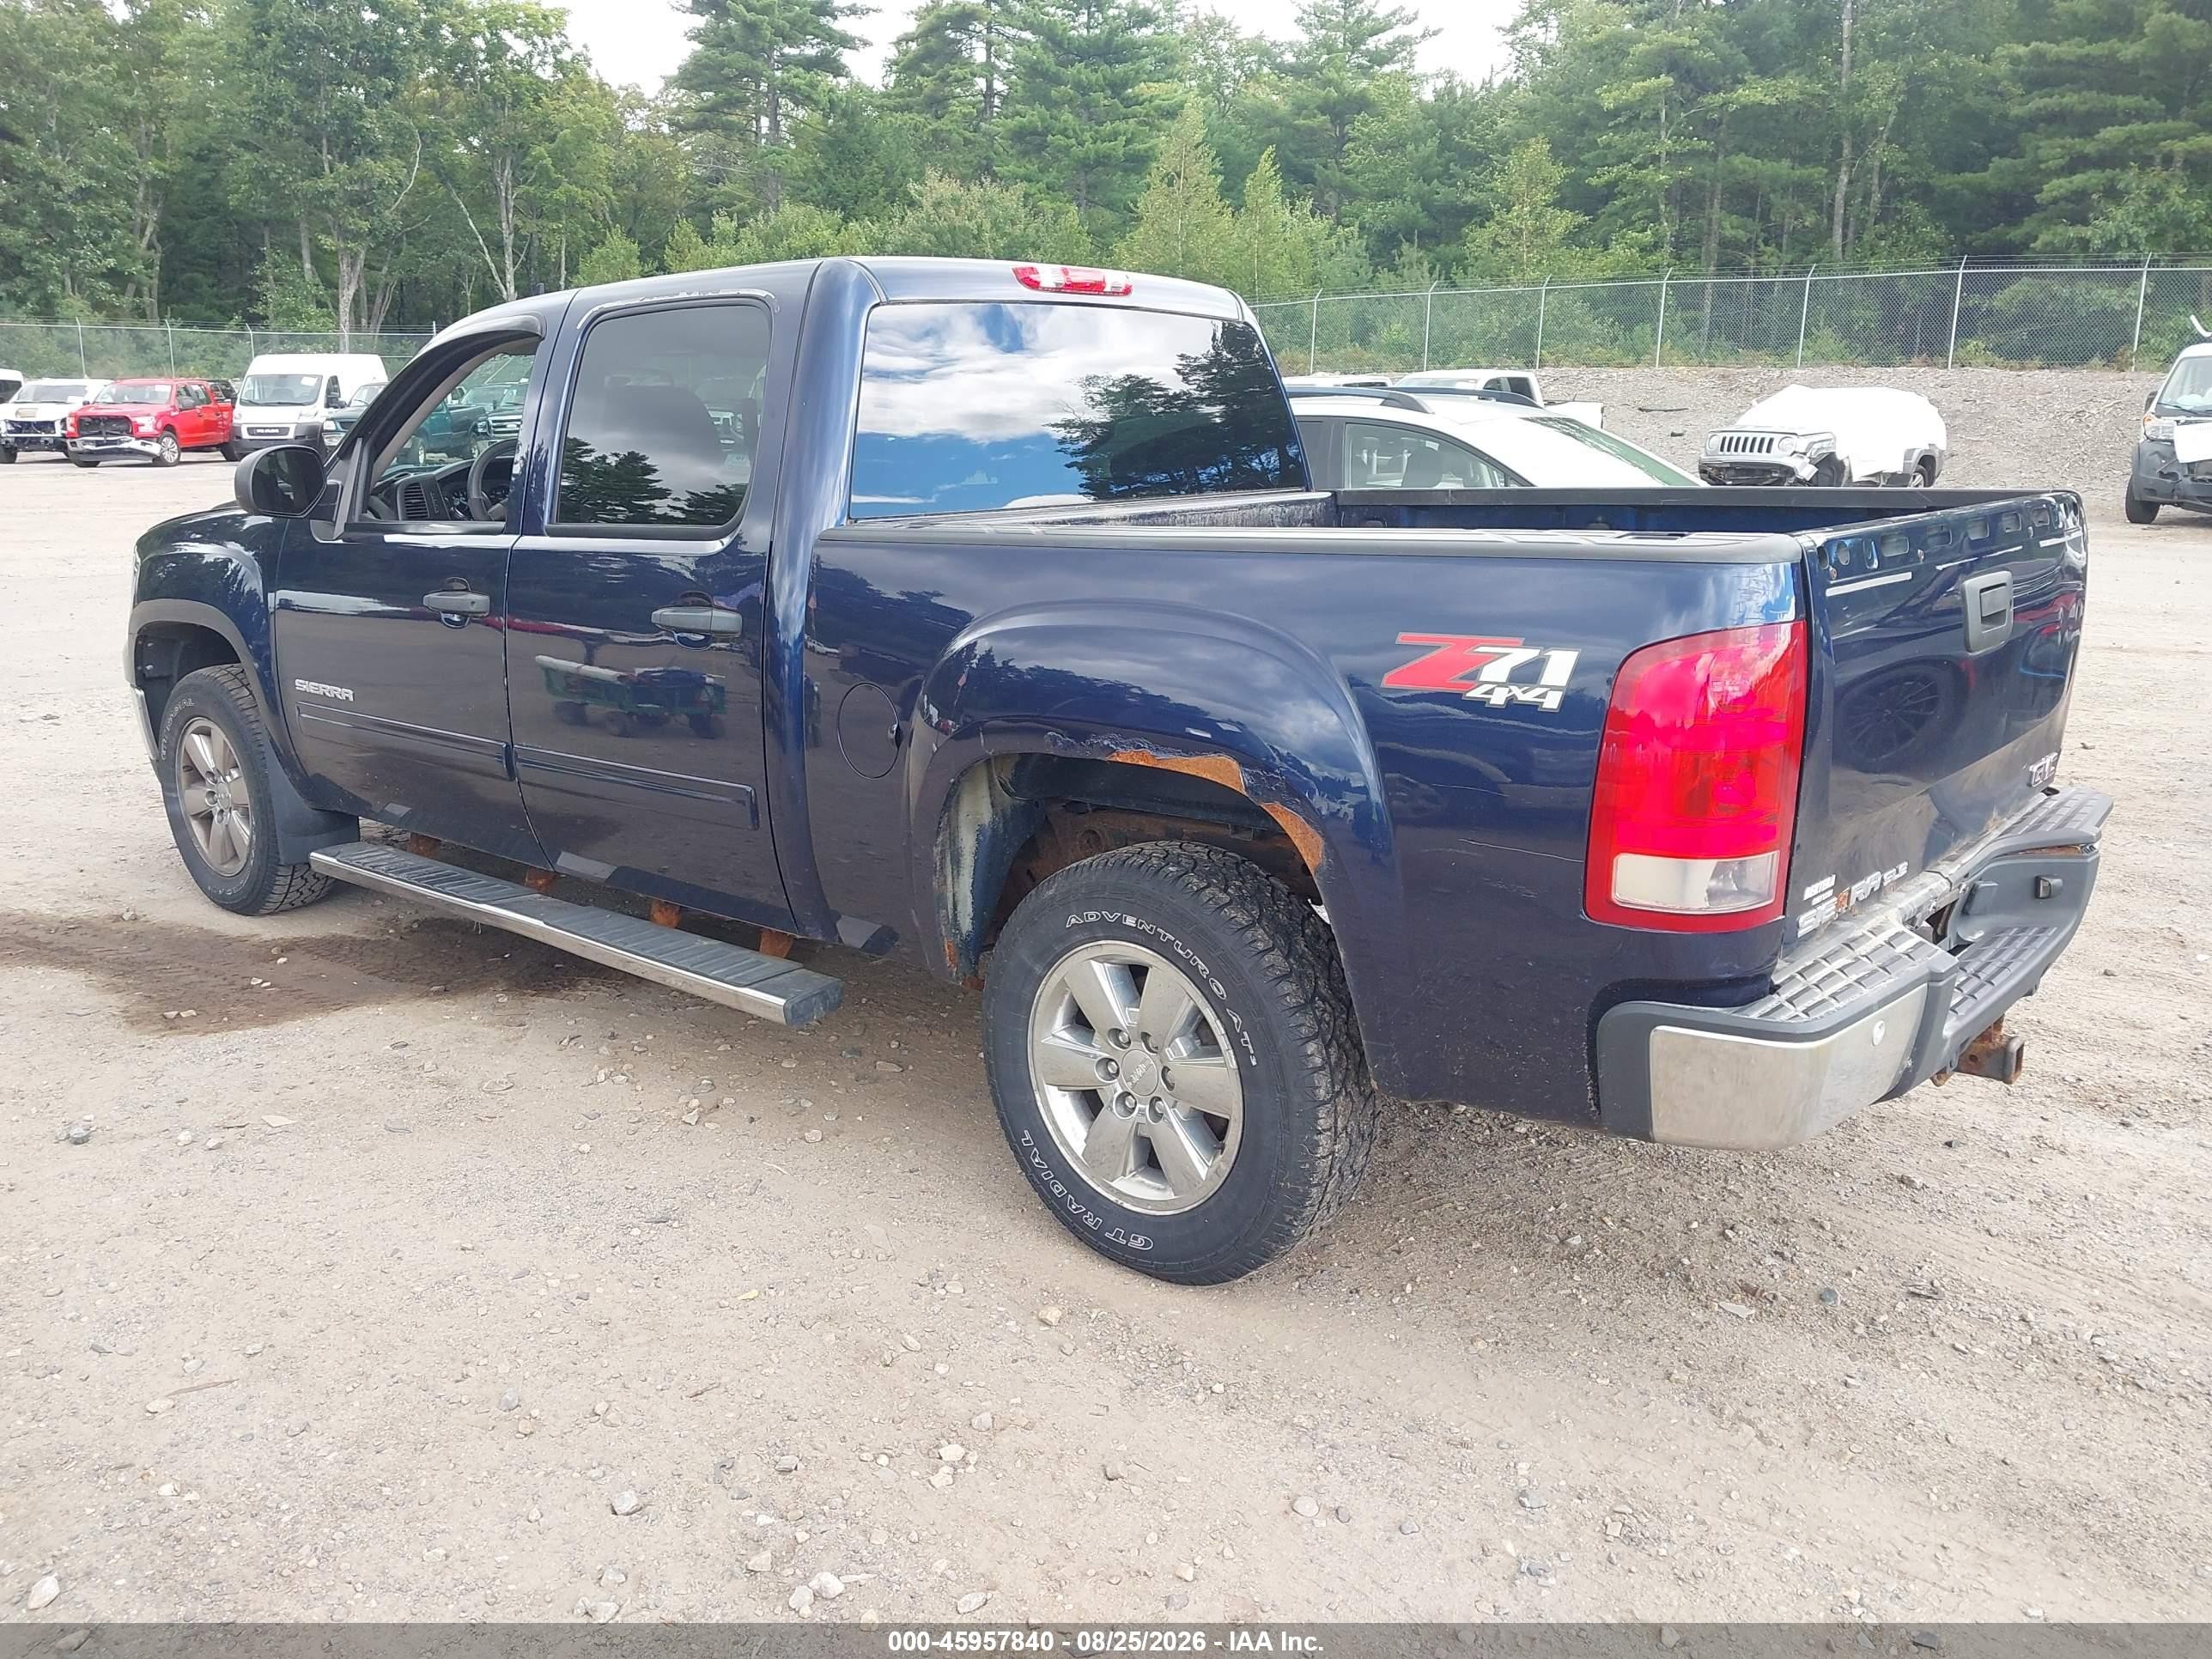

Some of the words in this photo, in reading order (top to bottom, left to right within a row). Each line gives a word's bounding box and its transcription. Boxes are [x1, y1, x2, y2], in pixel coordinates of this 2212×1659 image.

[295, 678, 356, 702] SIERRA
[1380, 632, 1582, 693] Z71
[1796, 871, 1881, 938] SIERA
[1066, 911, 1227, 1000] ADVENTURO
[1021, 1129, 1103, 1231] RADIAL
[1104, 1227, 1154, 1250] GT
